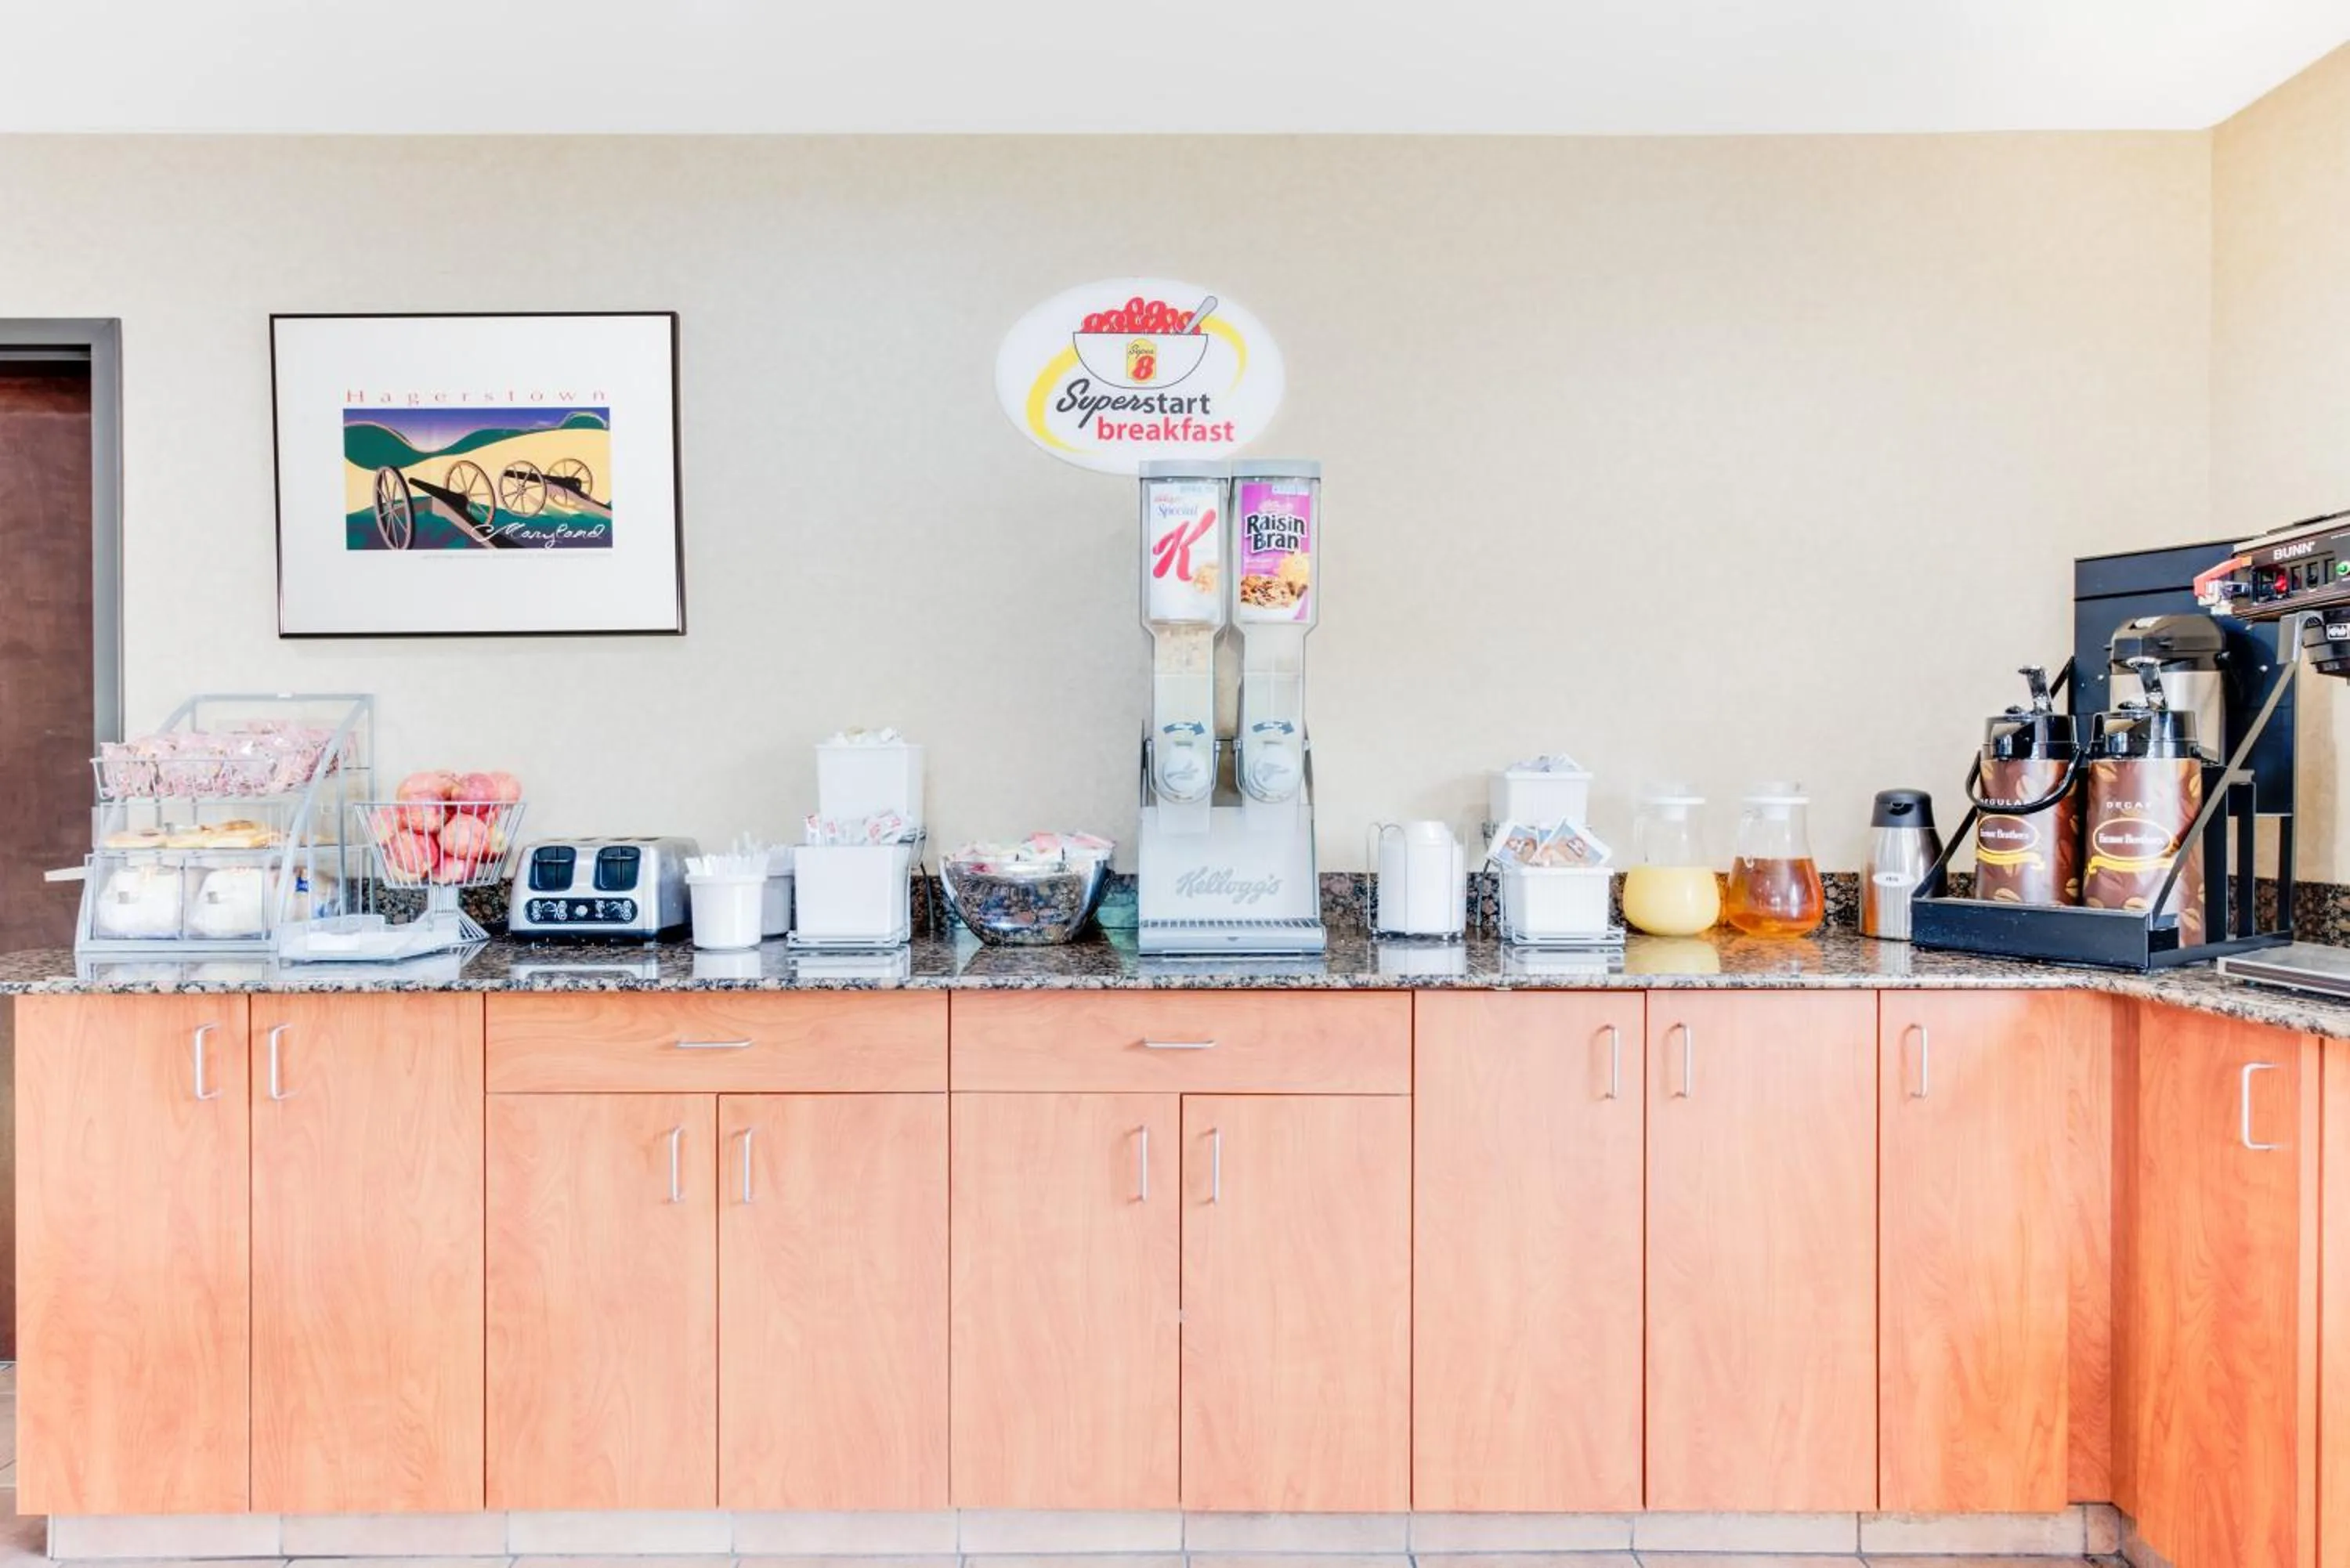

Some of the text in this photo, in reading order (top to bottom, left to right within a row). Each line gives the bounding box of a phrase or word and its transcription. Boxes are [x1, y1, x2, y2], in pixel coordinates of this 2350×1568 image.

[1133, 356, 1154, 380] 8
[347, 389, 606, 405] Hagerstown
[1055, 378, 1211, 429] Superstart
[1097, 416, 1235, 443] breakfast
[470, 522, 604, 550] Maryland
[1246, 515, 1305, 535] Raisin
[1153, 508, 1216, 582] K
[1253, 533, 1299, 550] Bran
[2273, 541, 2313, 560] BUNN
[1175, 865, 1284, 905] Kellogg's
